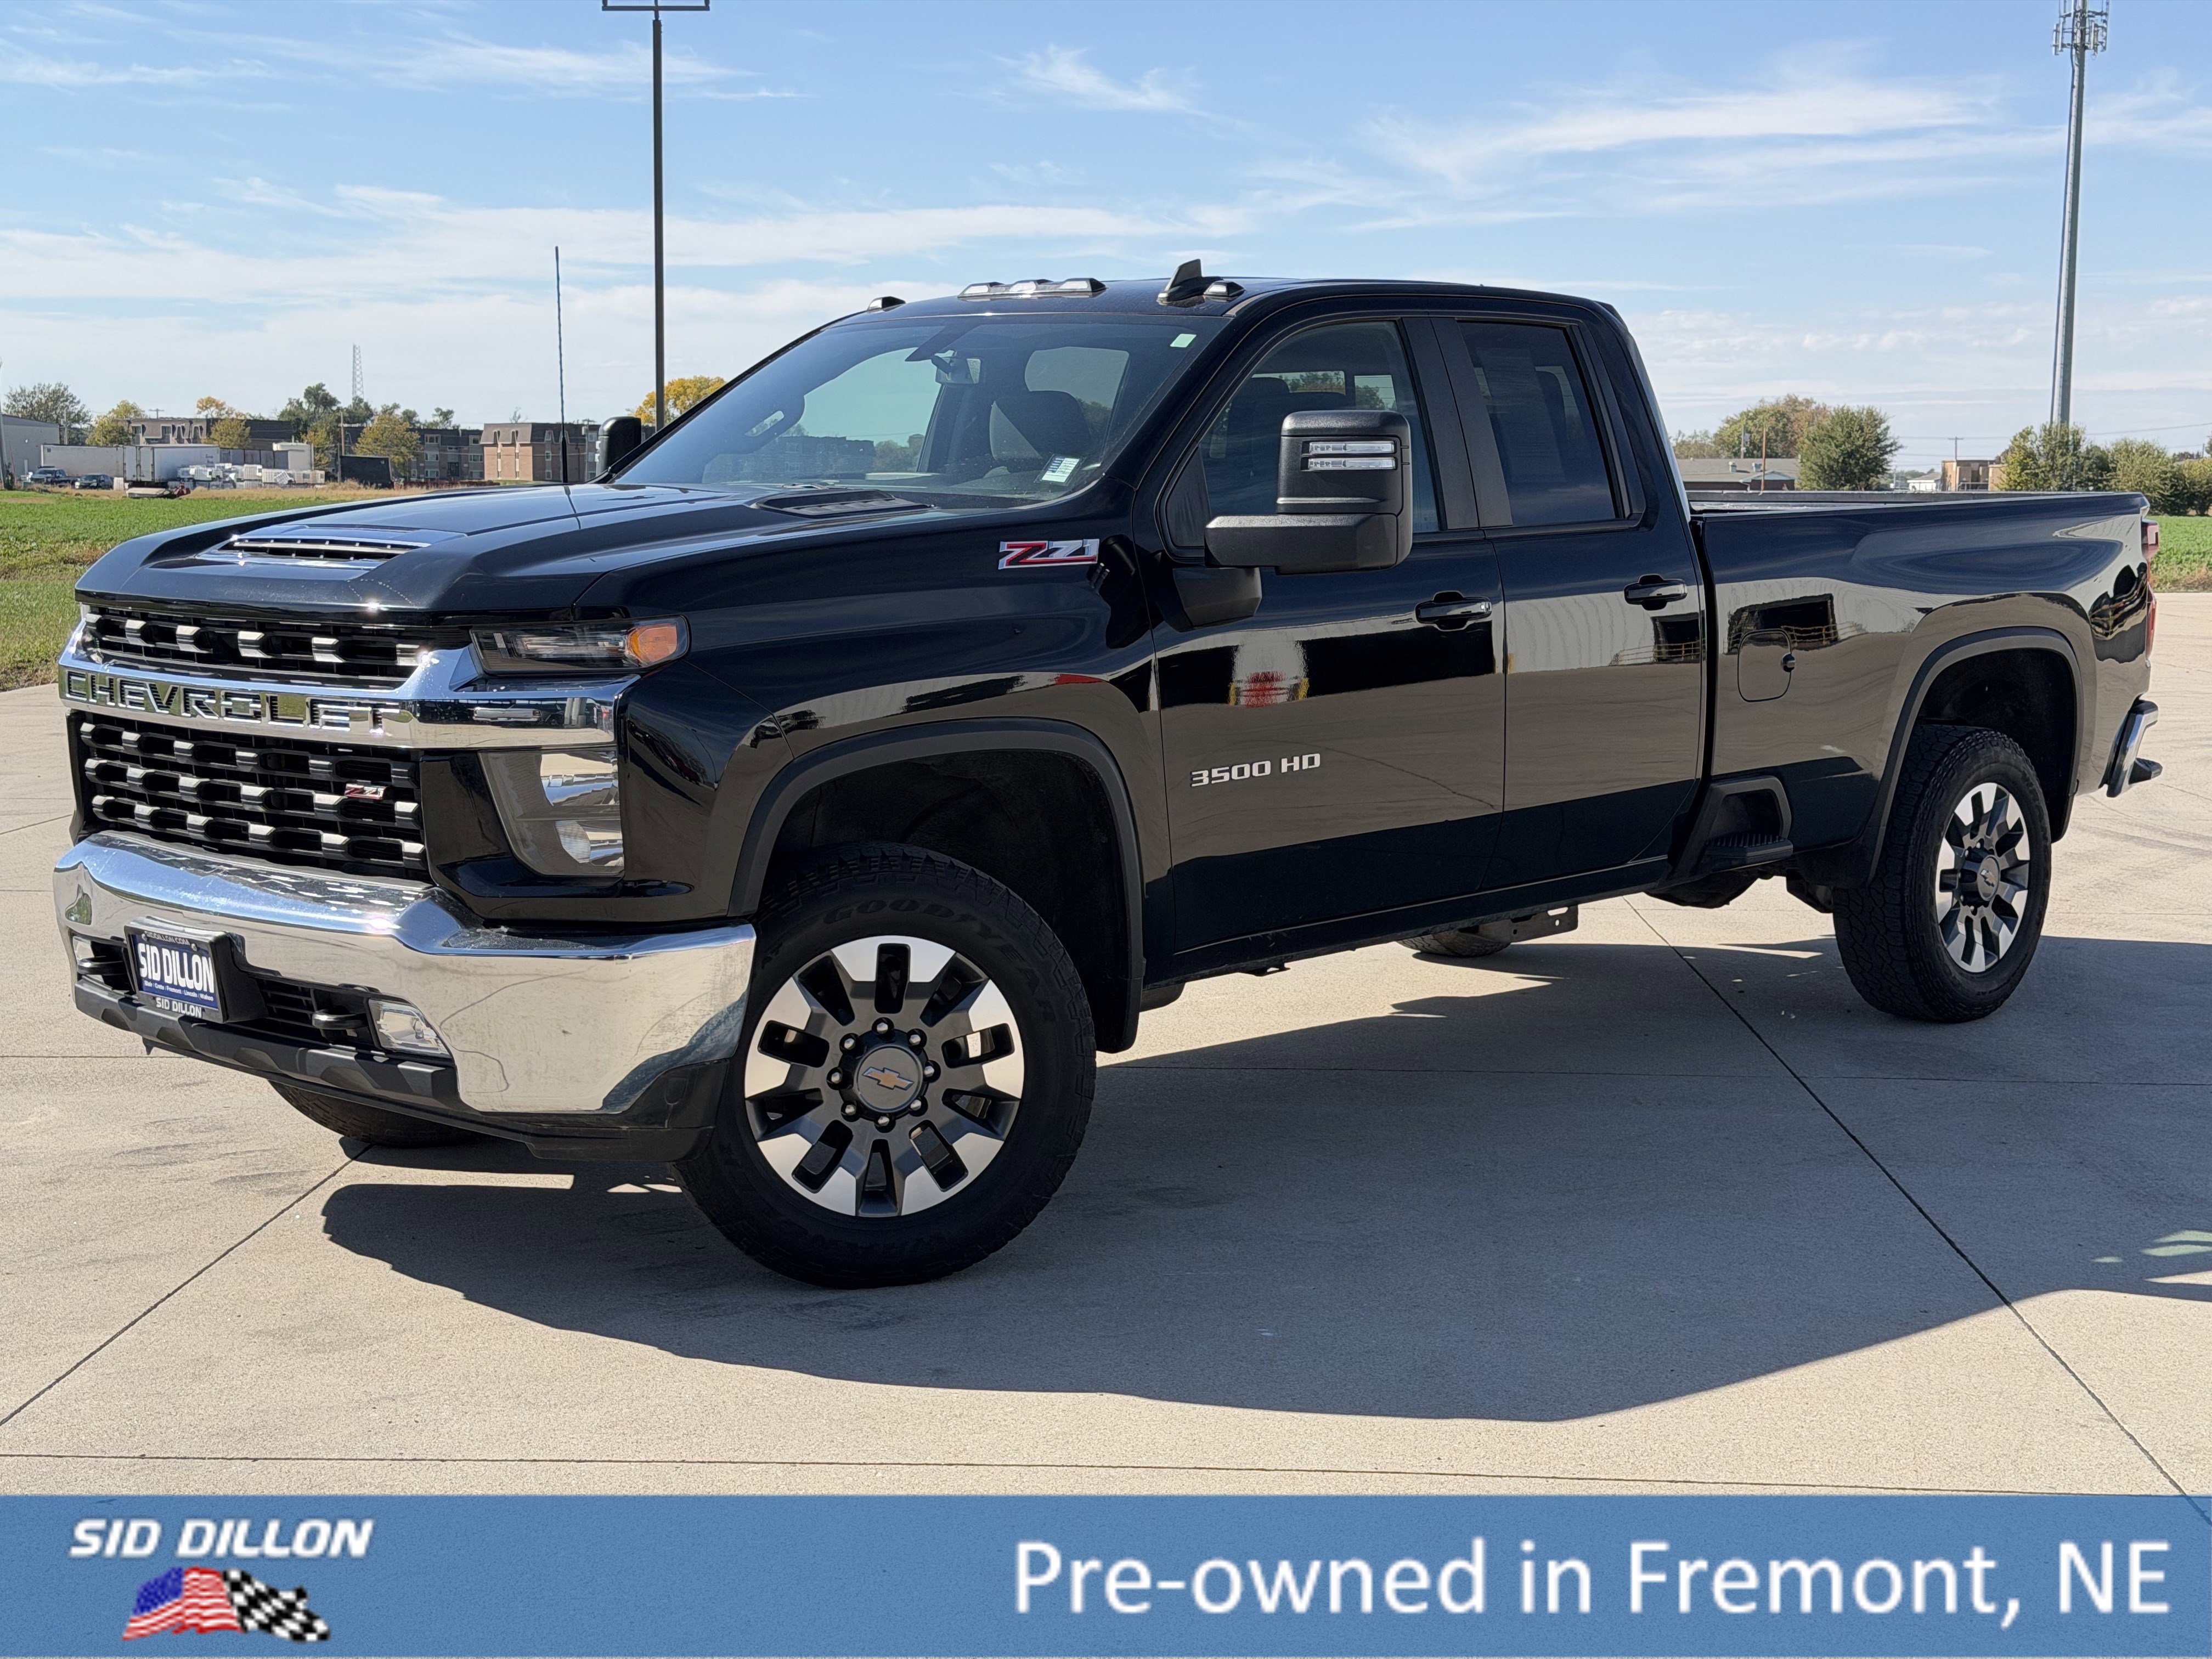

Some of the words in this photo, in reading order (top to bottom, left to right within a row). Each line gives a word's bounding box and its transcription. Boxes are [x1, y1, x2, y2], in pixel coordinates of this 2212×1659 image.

[998, 539, 1099, 569] Z71
[65, 669, 400, 735] CHEVROLET
[1190, 760, 1271, 787] 3500
[1280, 753, 1321, 774] HD
[138, 943, 161, 981] SID
[162, 947, 215, 993] DILLON
[156, 997, 170, 1010] SID
[172, 1001, 202, 1019] DILLON
